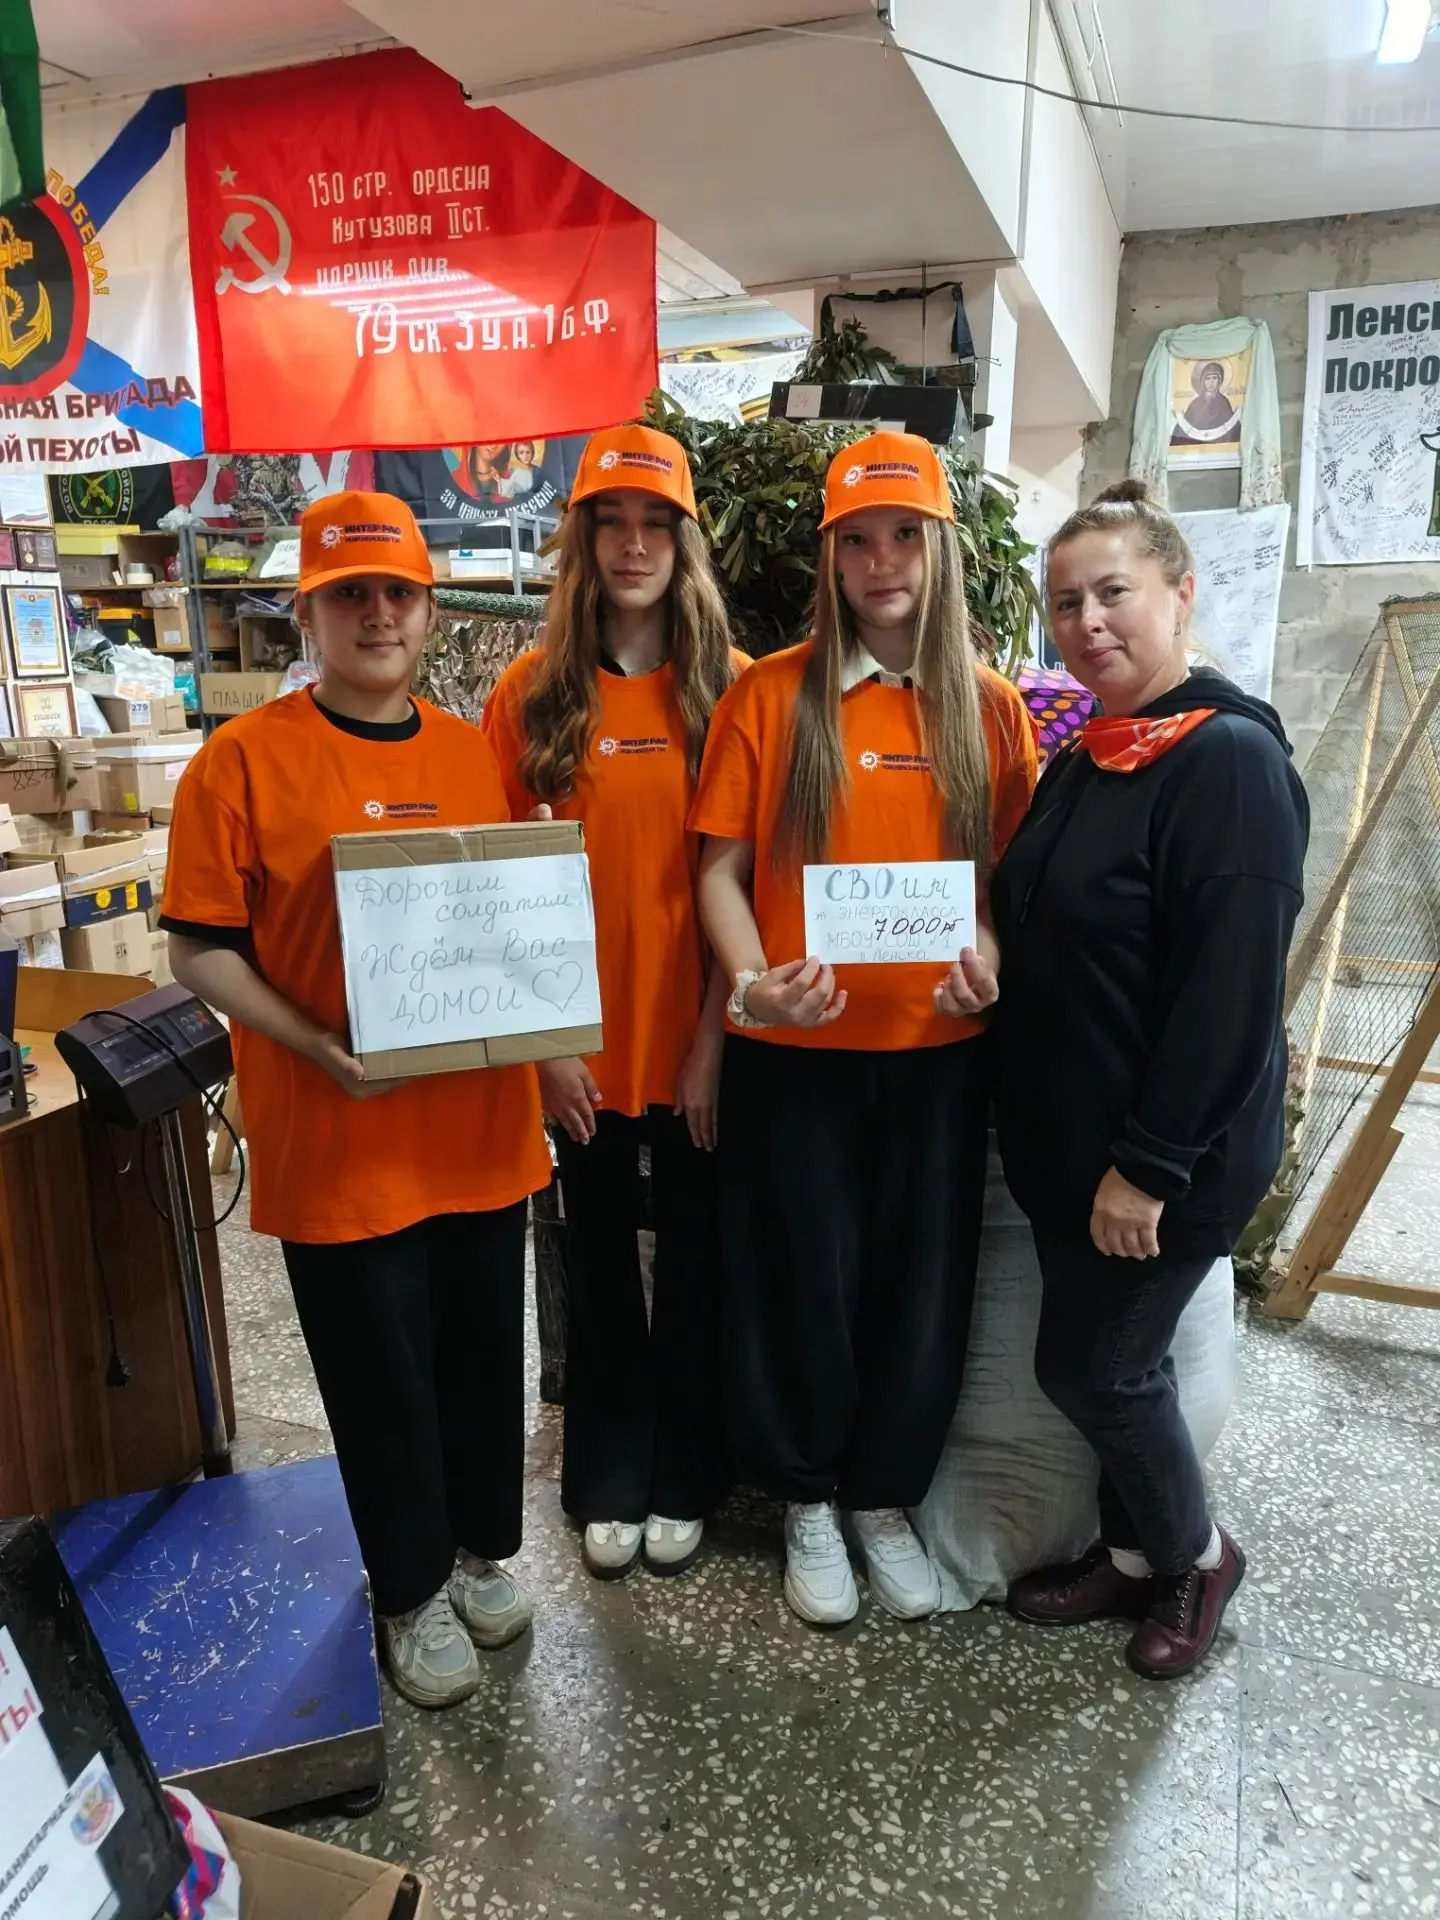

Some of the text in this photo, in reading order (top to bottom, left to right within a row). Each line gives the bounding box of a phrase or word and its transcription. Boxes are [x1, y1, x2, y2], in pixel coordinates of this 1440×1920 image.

[308, 171, 344, 209] 150
[412, 165, 490, 195] ОРДЕНА
[46, 168, 109, 296] ПОБЕДА!
[352, 301, 398, 358] 79
[0, 375, 197, 420] НАЯ БРИГАДА
[27, 428, 142, 462] ПЕХОТЫ
[131, 703, 149, 712] 279
[355, 875, 507, 915] Дорогим
[502, 928, 568, 963] Вас
[390, 971, 523, 1031] ДОМОЙ
